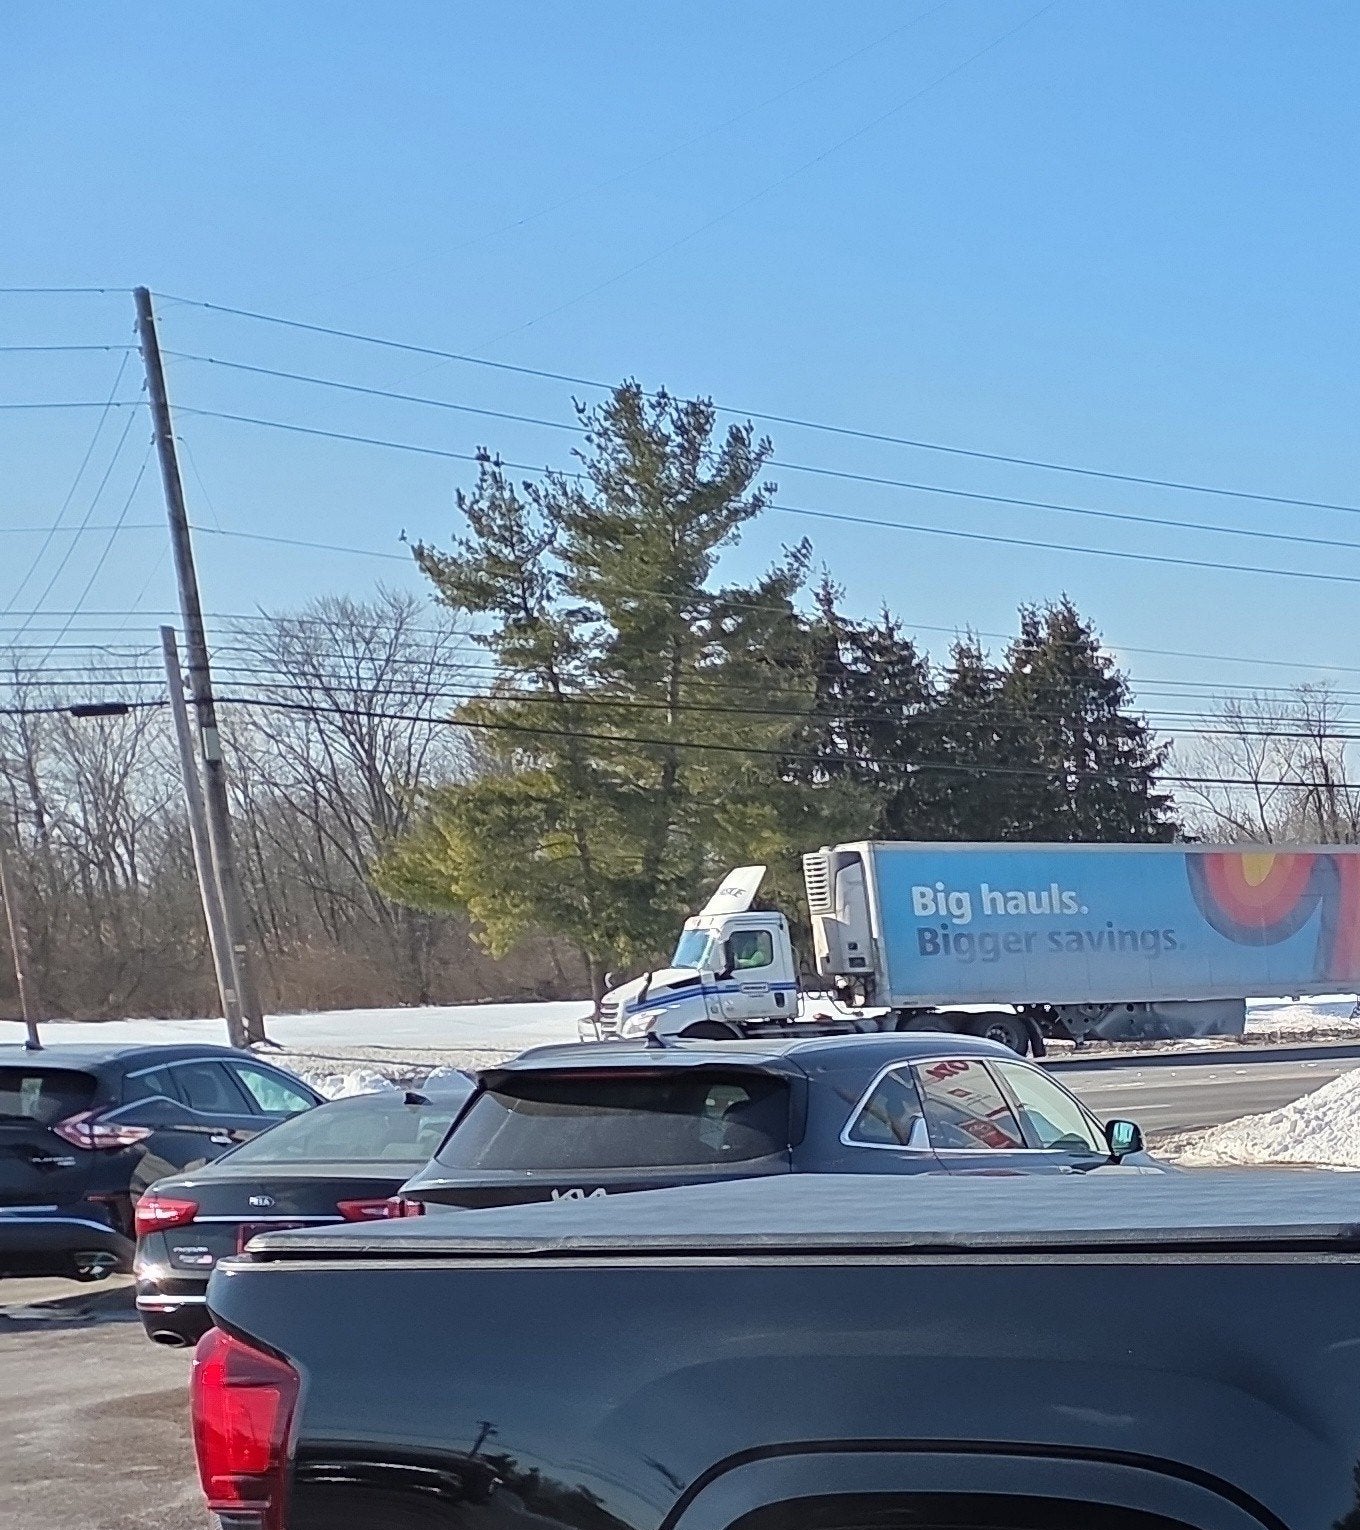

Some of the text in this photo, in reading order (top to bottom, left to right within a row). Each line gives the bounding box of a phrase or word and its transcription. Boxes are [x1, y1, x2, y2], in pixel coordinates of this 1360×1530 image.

[911, 881, 1090, 925] Big hauls.
[916, 920, 1187, 964] Bigger savings.
